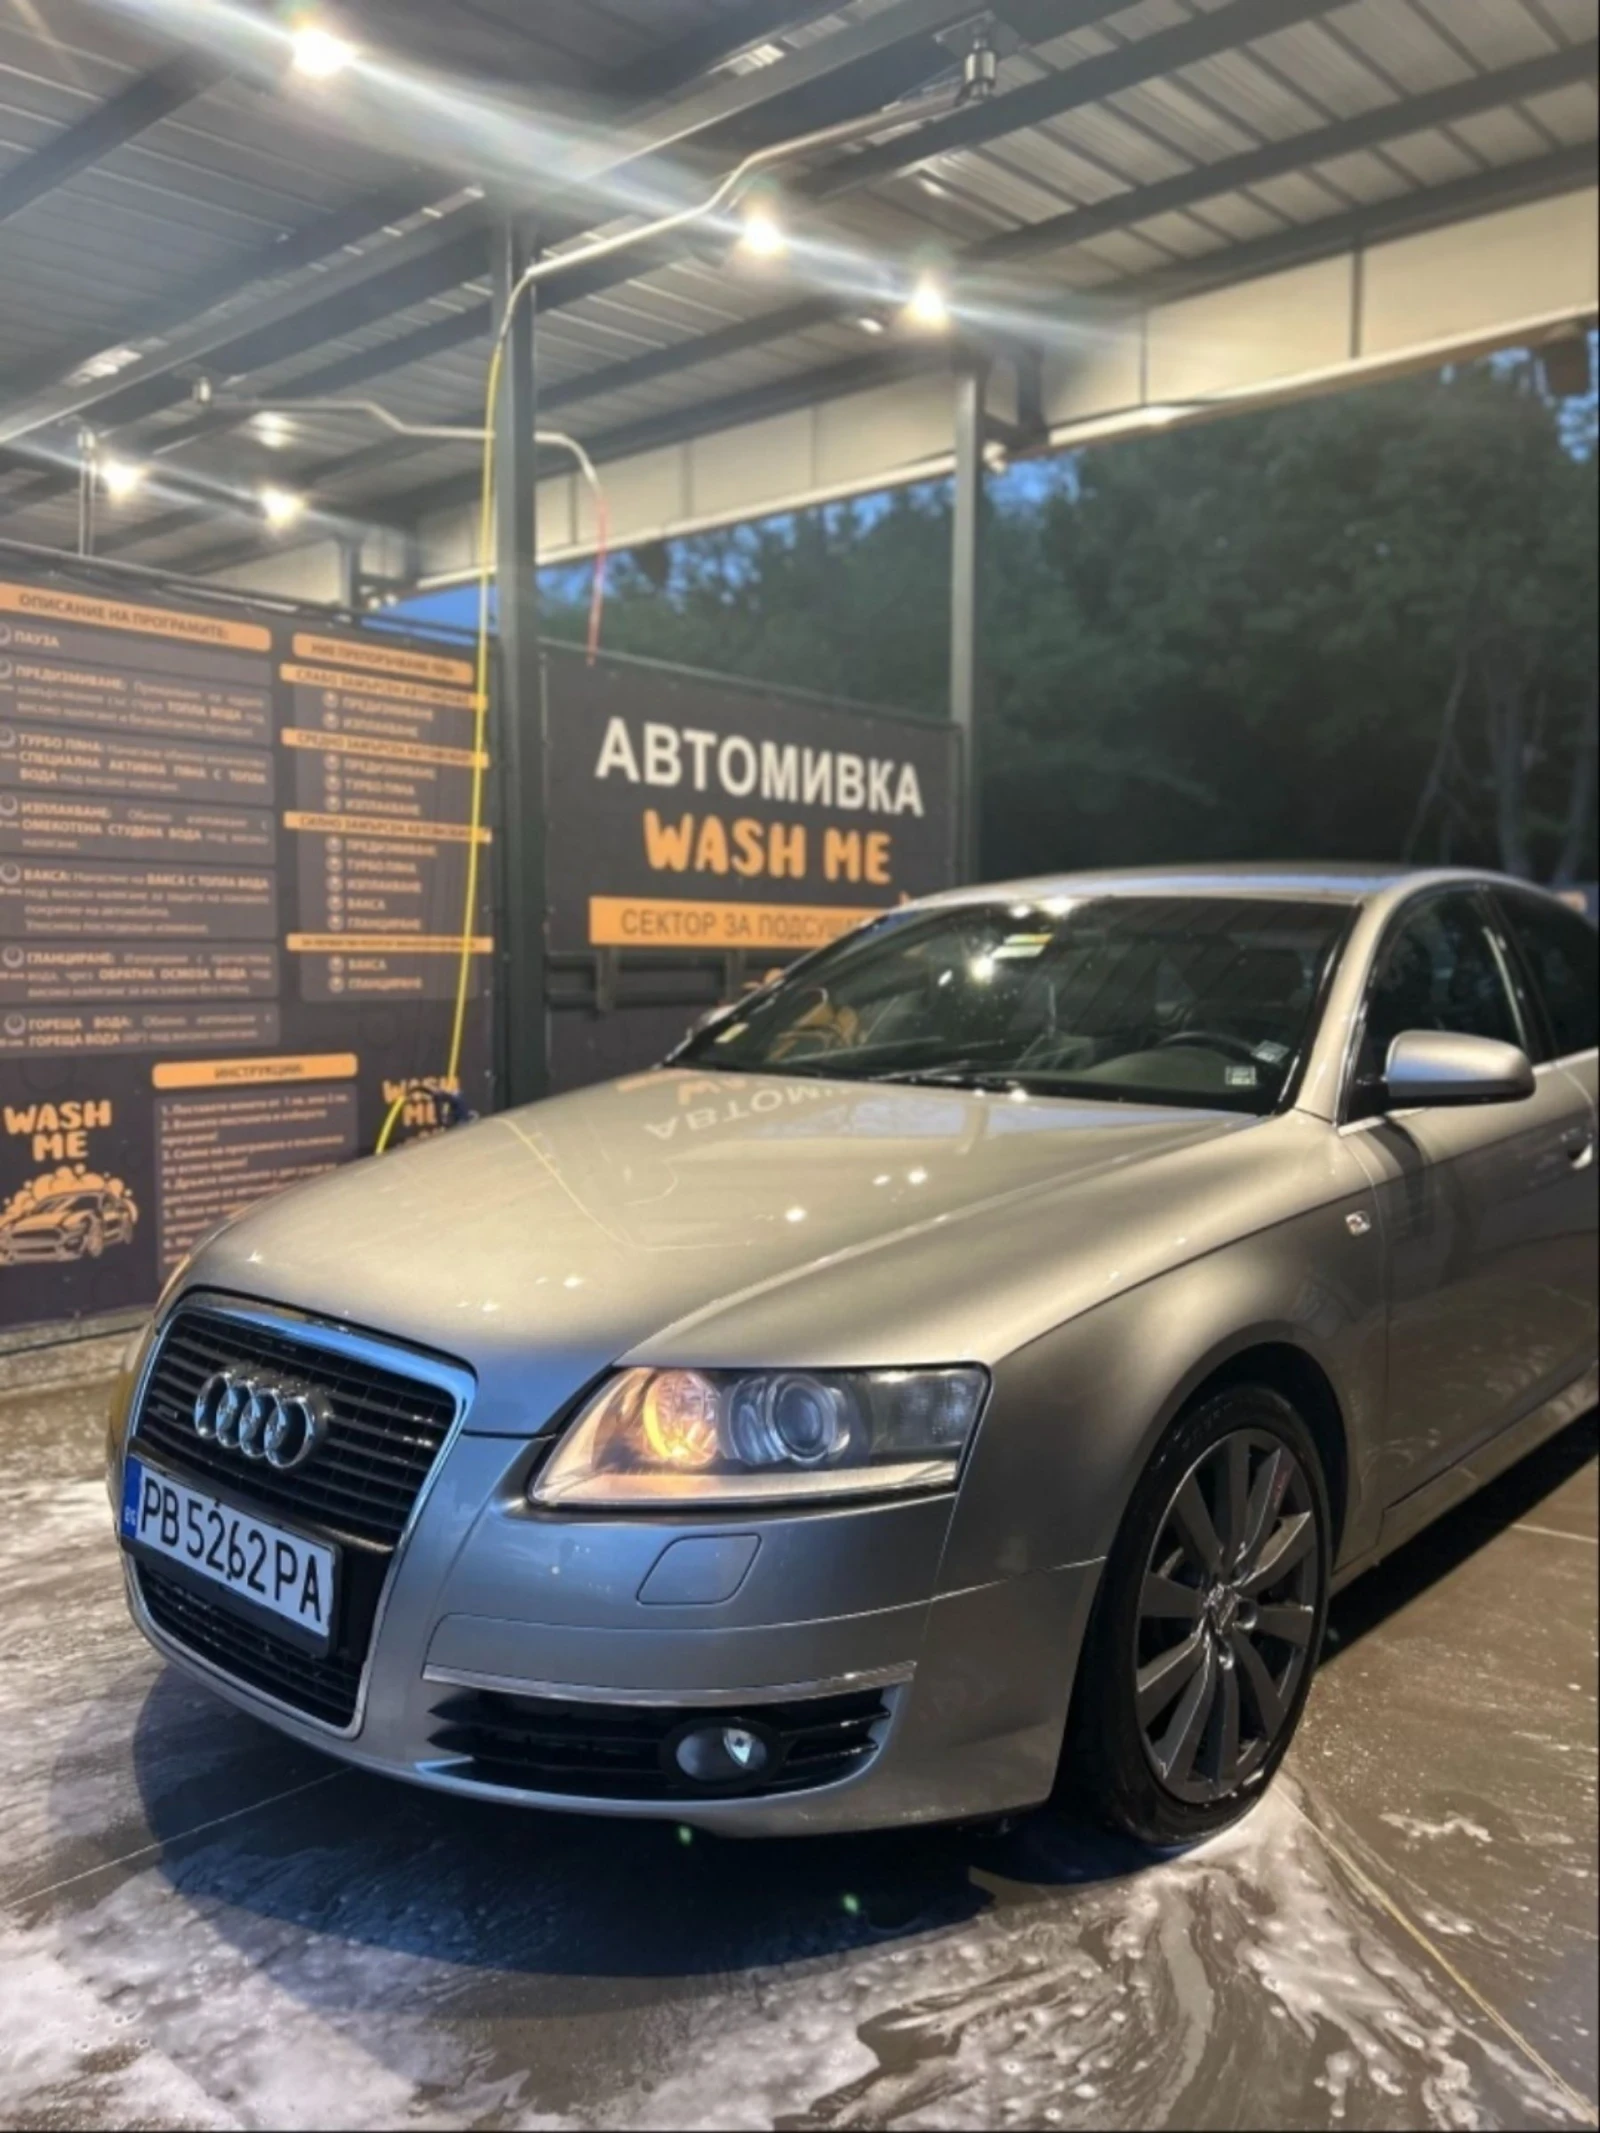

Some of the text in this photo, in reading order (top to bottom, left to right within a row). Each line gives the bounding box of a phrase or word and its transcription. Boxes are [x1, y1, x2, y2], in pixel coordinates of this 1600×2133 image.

[19, 593, 106, 621] ОПИСАНИЕ
[109, 606, 129, 624] НА
[14, 629, 60, 648] ПАУЗА
[19, 732, 62, 750] ТУРБО
[20, 749, 100, 769] СПЕЦИАЛНА
[109, 758, 166, 776] АКТИВНА
[595, 717, 924, 817] АВТОМИВКА
[20, 767, 57, 784] ВОДА
[22, 818, 102, 836] ОМЕКОТЕНА
[107, 823, 164, 840] СТУДЕНА
[169, 826, 202, 842] ВОДА
[643, 809, 892, 885] WASH ME
[23, 868, 71, 883] ВАКСА:
[620, 908, 716, 938] СЕКТОР
[723, 911, 752, 938] ЗА
[98, 967, 156, 981] ОБРАТНА
[215, 967, 248, 981] ВОДА
[29, 1016, 83, 1032] ГОРЕЩА
[29, 1032, 84, 1048] ГОРЕЩА
[86, 1031, 121, 1046] ВОДА
[4, 1099, 114, 1136] WASH
[32, 1129, 90, 1162] ME
